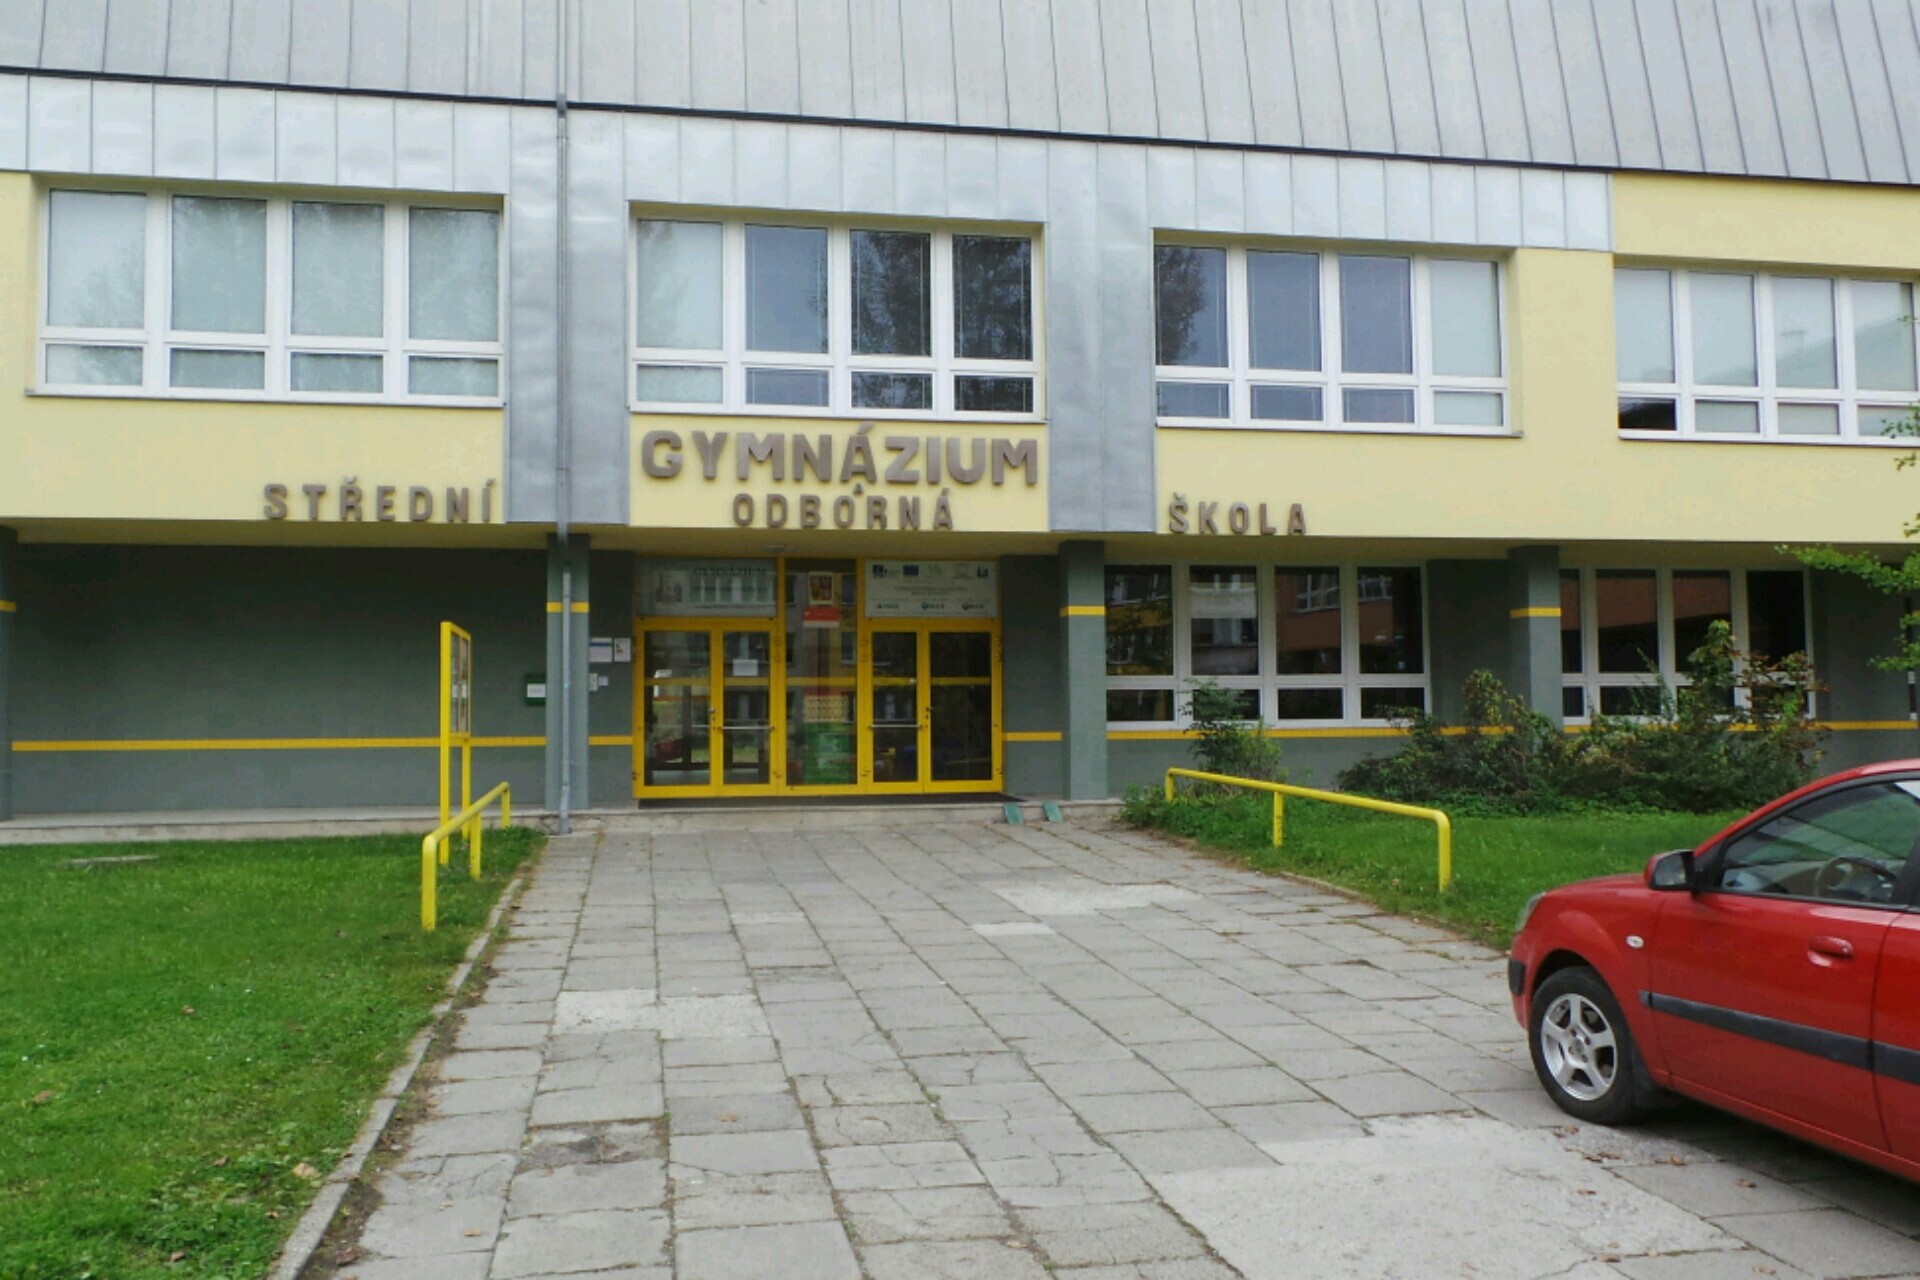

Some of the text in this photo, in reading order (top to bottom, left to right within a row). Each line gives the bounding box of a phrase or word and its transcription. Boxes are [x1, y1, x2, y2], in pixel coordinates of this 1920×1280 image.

[641, 421, 1038, 485] GYMNÁZIUM
[263, 475, 496, 523] STŘEDNÍ
[732, 487, 954, 530] ODBORNÁ
[1169, 491, 1306, 535] ŠKOLA
